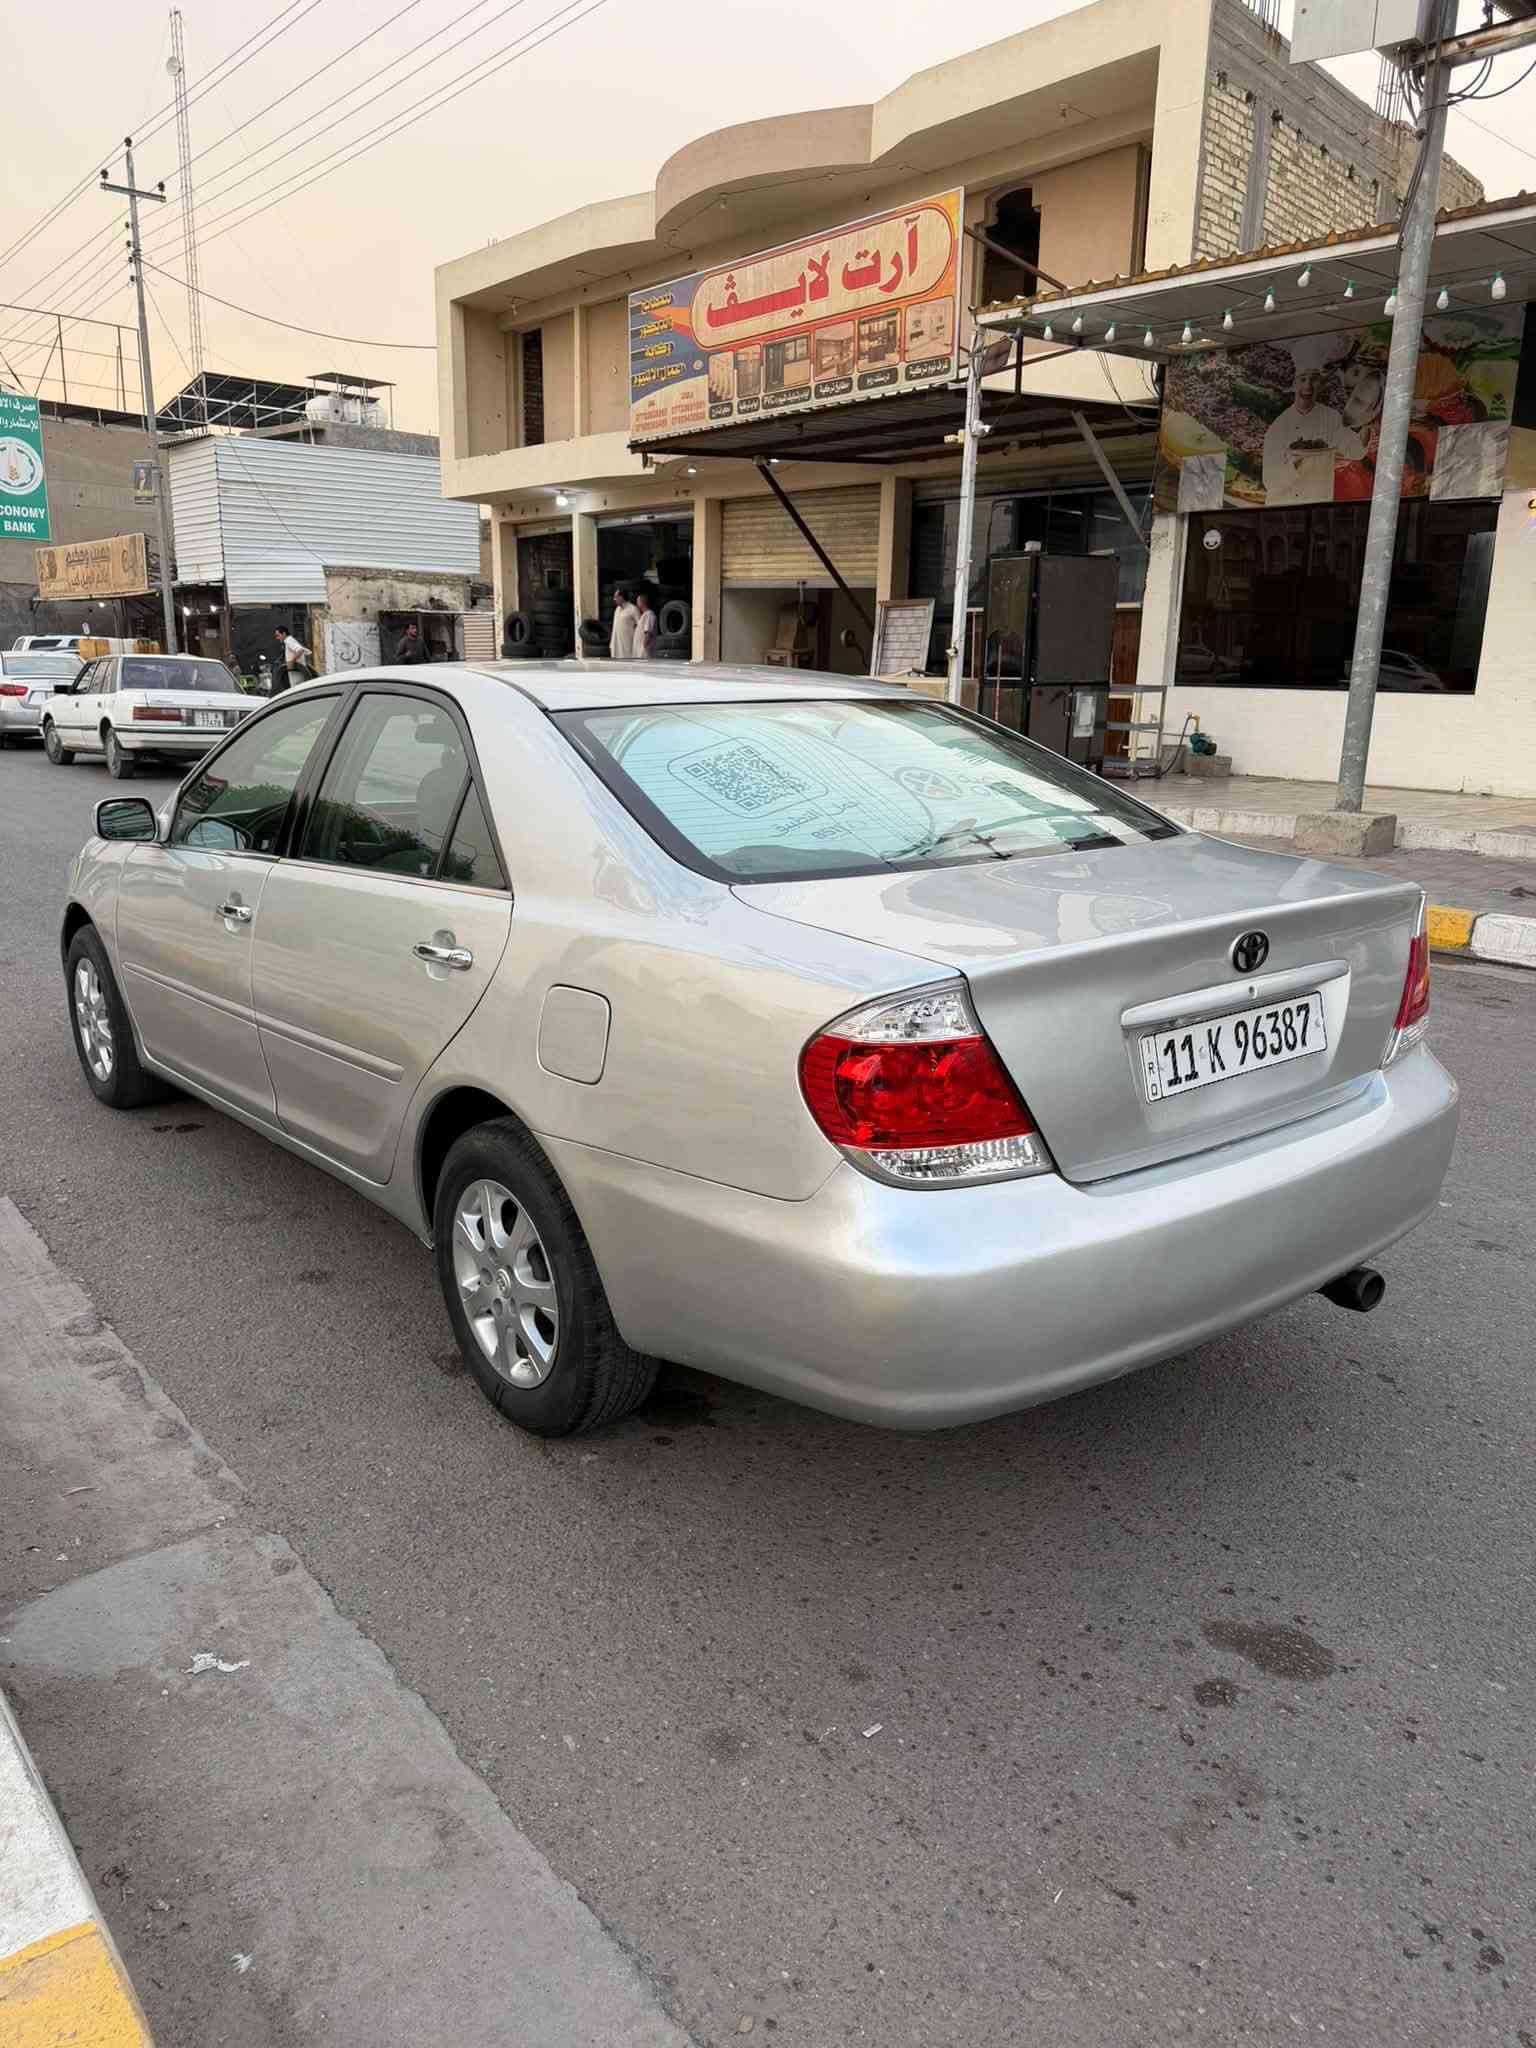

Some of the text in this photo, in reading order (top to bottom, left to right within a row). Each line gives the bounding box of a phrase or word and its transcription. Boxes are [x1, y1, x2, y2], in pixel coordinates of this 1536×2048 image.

[842, 214, 921, 293] آرت
[4, 520, 36, 533] BANK
[1163, 1002, 1310, 1087] 11 K 96387
